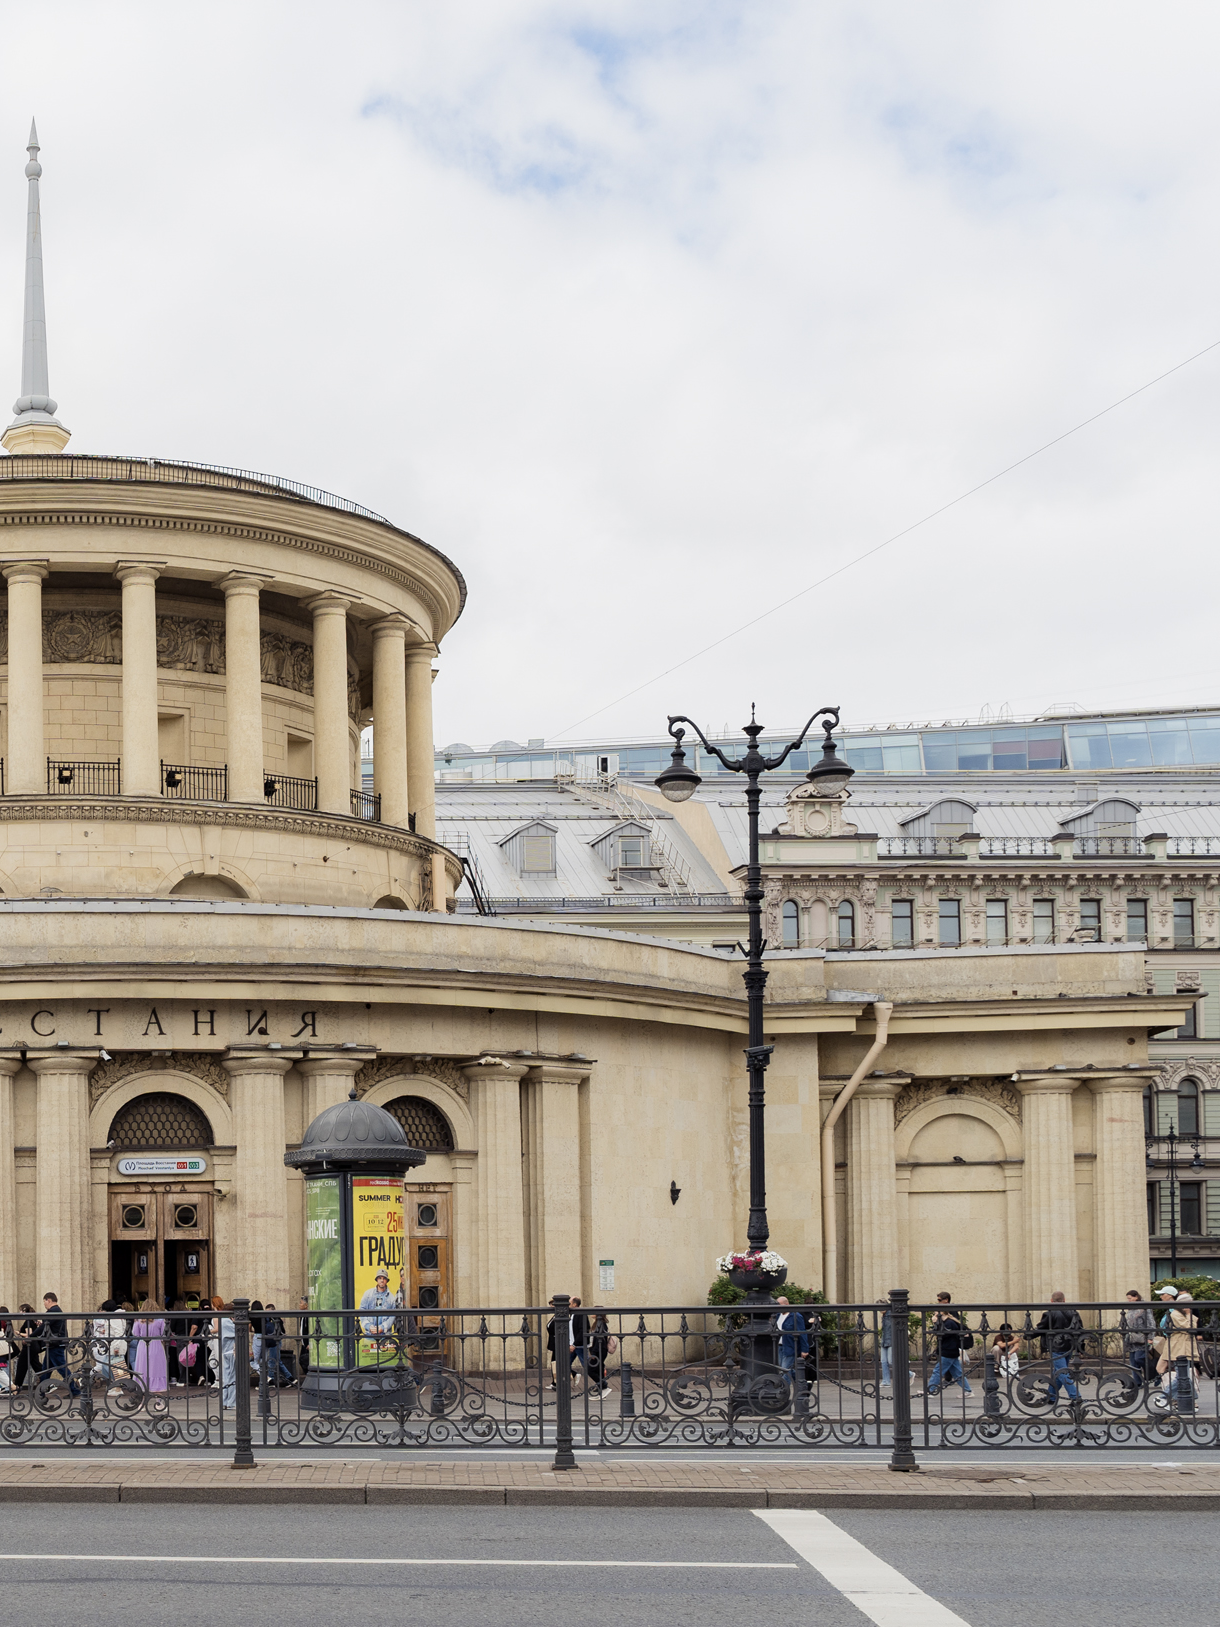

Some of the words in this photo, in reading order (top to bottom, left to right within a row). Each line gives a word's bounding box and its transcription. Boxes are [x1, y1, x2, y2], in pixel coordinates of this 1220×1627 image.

[134, 1184, 187, 1192] ВХОД
[418, 1184, 438, 1192] НЕТ
[387, 1211, 398, 1233] 25
